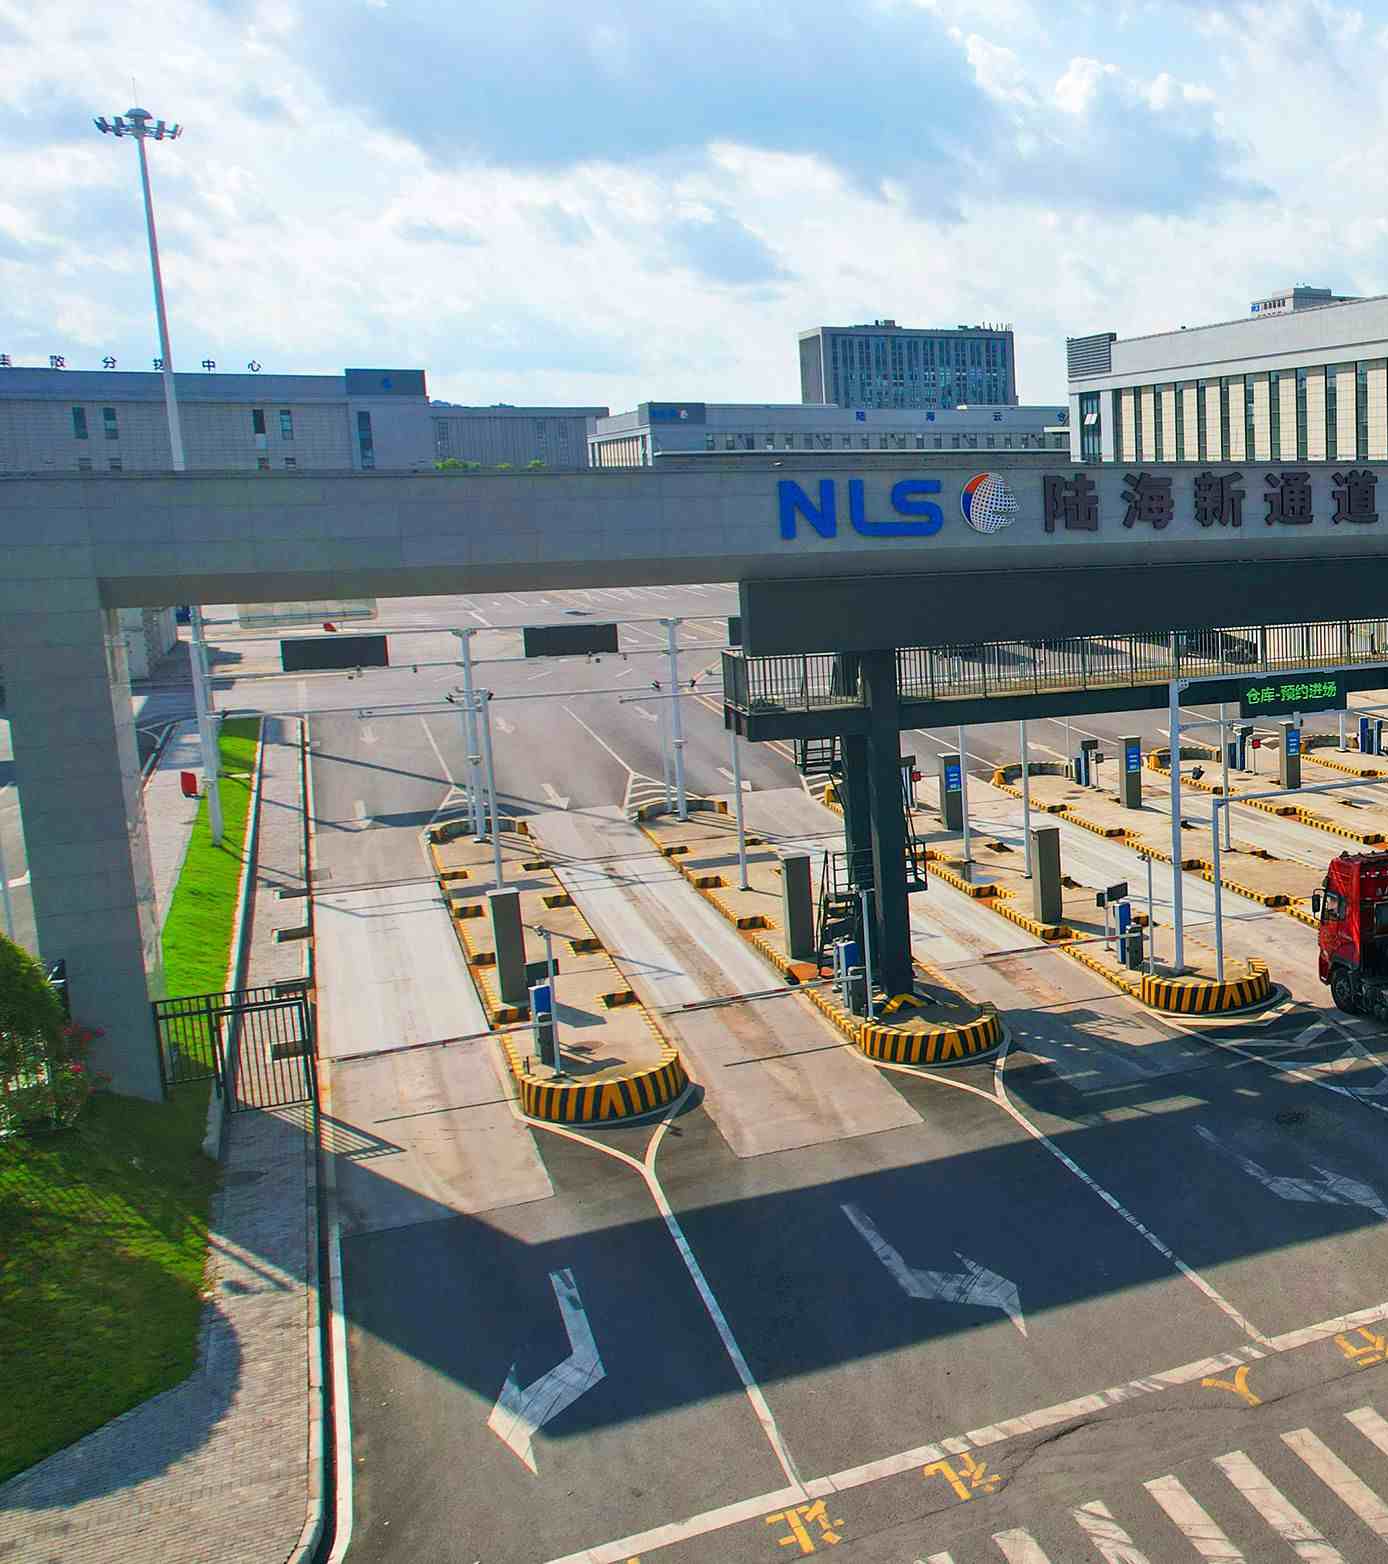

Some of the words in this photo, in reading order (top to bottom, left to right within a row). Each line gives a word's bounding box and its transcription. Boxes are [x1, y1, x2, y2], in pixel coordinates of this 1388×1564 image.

[777, 479, 944, 540] NLS
[1246, 681, 1337, 704] 仓库-预约进场
